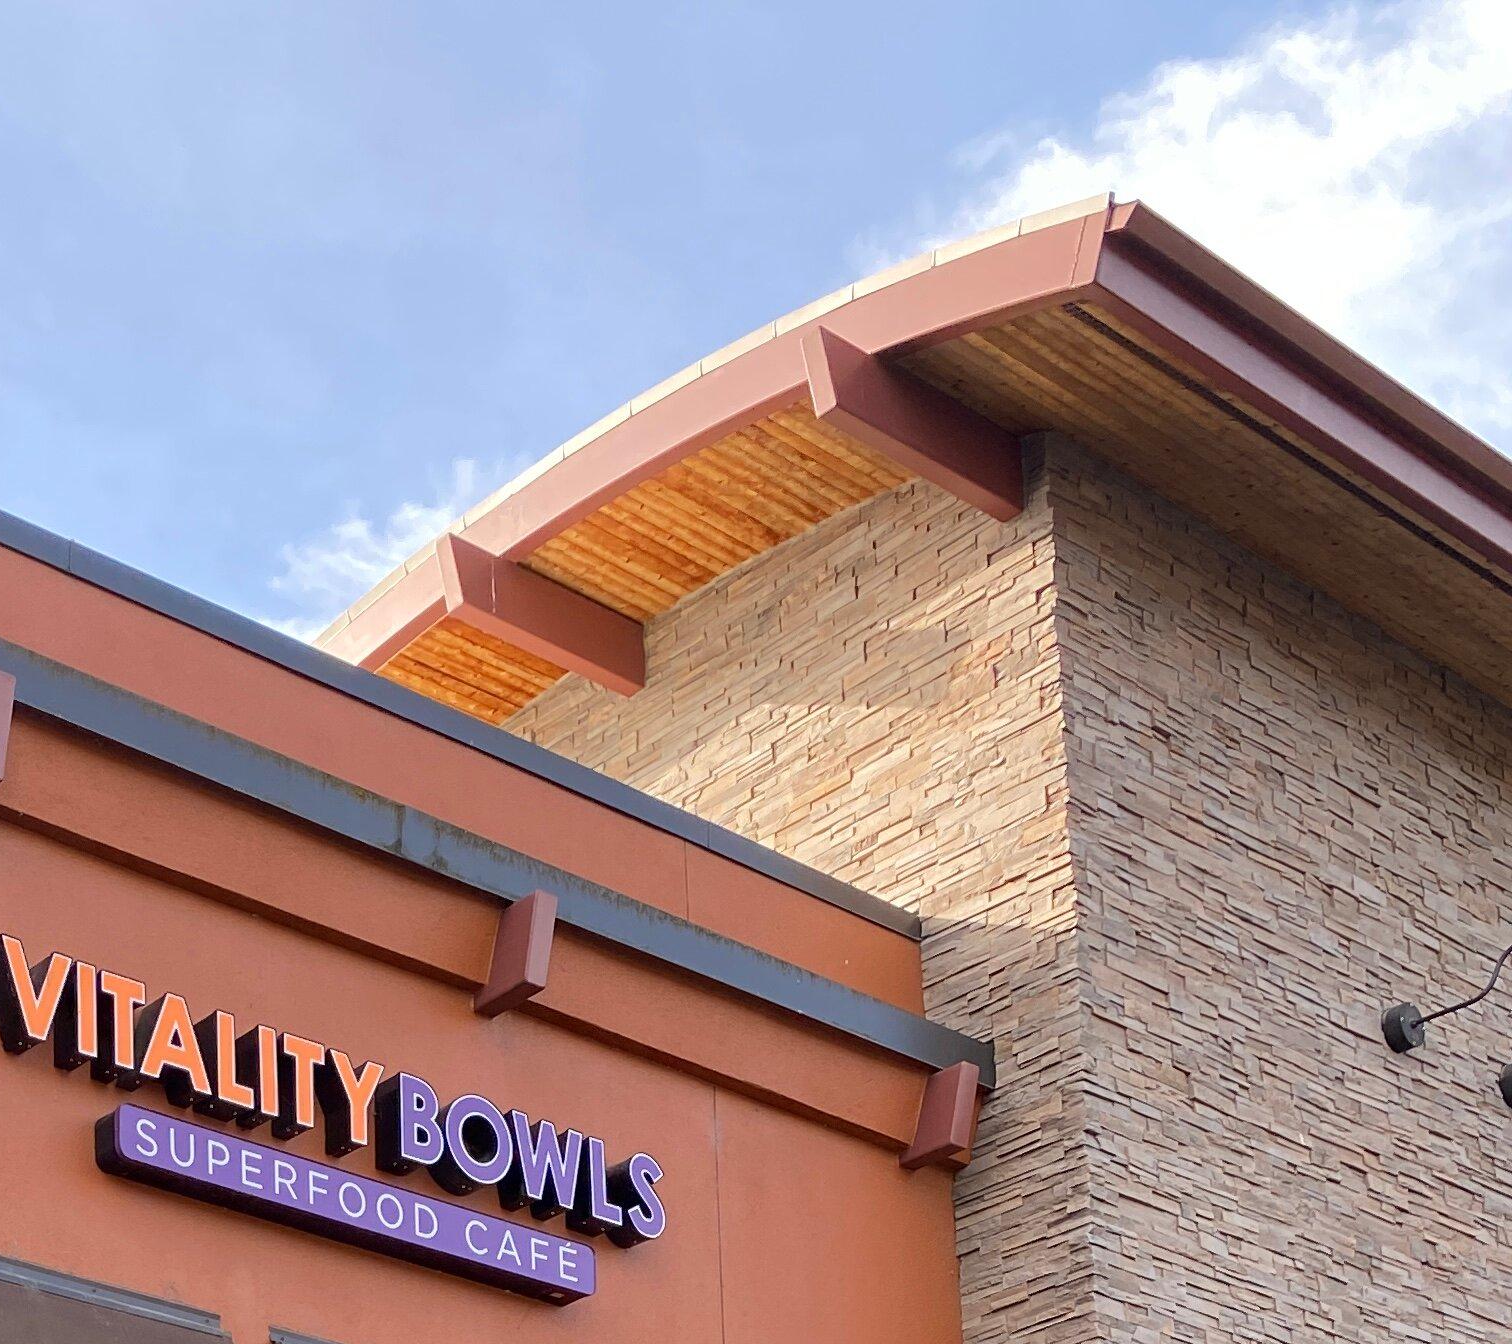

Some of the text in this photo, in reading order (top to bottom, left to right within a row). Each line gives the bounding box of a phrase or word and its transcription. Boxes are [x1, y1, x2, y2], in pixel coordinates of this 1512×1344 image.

[136, 1118, 580, 1283] SUPERFOOD CAFÉ
[399, 1072, 666, 1239] BOWLS
